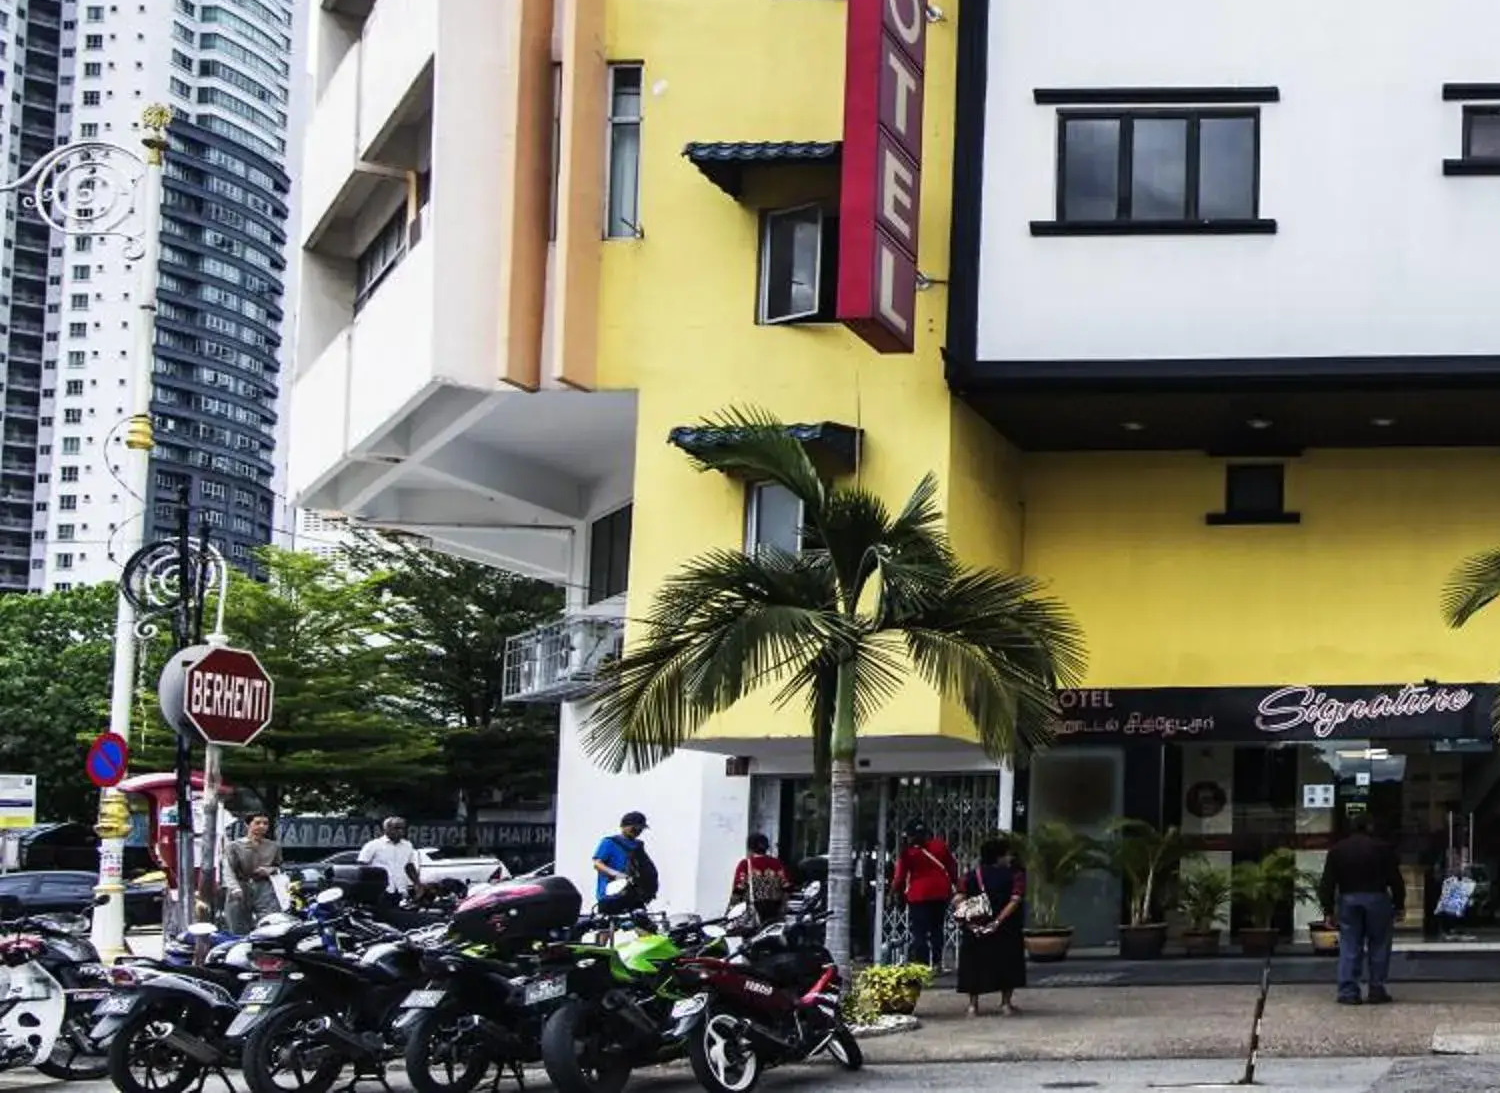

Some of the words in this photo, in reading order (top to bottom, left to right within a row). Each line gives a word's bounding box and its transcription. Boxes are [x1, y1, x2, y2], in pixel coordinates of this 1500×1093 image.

[191, 670, 268, 722] BERHENTI
[1055, 690, 1114, 709] OTEL
[1255, 683, 1473, 738] Signature
[317, 822, 384, 846] DATAN
